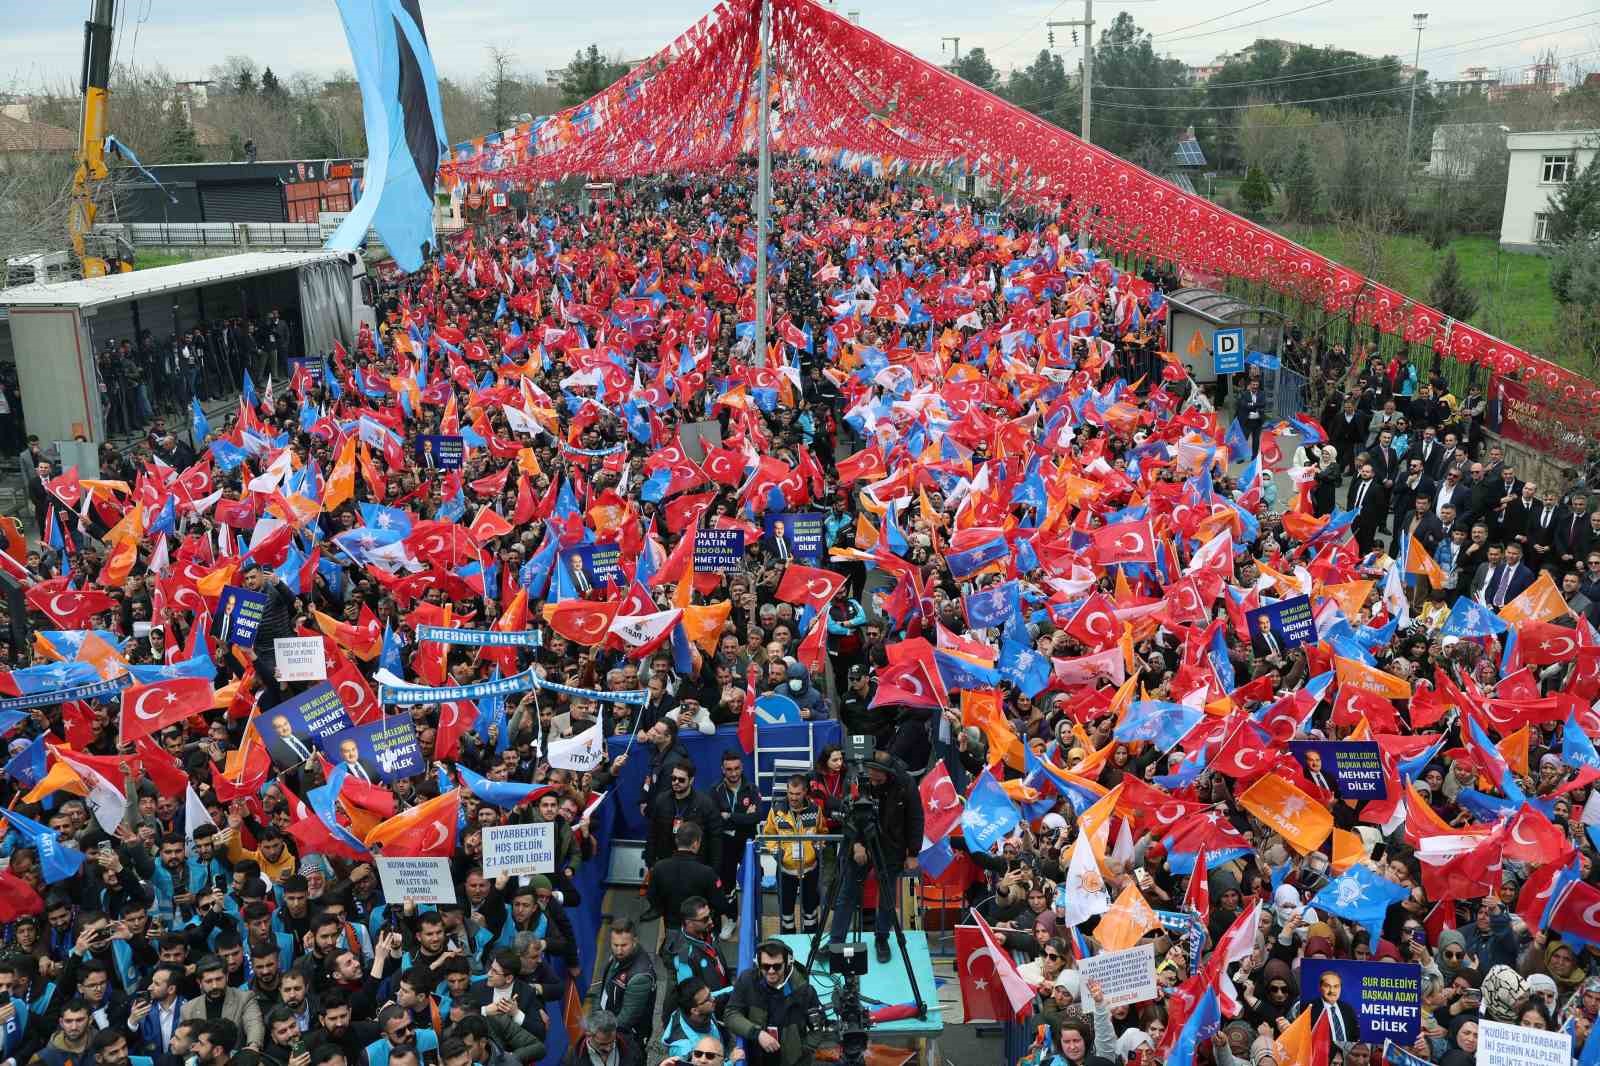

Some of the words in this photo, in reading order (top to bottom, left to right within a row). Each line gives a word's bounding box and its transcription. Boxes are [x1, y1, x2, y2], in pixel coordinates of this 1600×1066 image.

[1221, 337, 1234, 352] D
[694, 556, 717, 564] HMET
[1282, 618, 1313, 633] MEHMET
[1290, 629, 1310, 641] DİLEK
[308, 707, 346, 732] MEHMET
[319, 720, 346, 738] DİLEK
[1338, 770, 1382, 779] MEHMET
[1347, 780, 1376, 791] DİLEK
[490, 827, 547, 841] DİYARBEKİR'E
[495, 841, 512, 853] HOŞ
[513, 838, 543, 852] GELDİN
[1362, 976, 1379, 987] SUR
[1380, 977, 1418, 990] BELEDİYE
[1362, 989, 1394, 1001] BAŞKAN
[1394, 991, 1419, 1003] ADAYI
[1361, 1003, 1419, 1018] MEHMET
[1371, 1018, 1408, 1033] DİLEK
